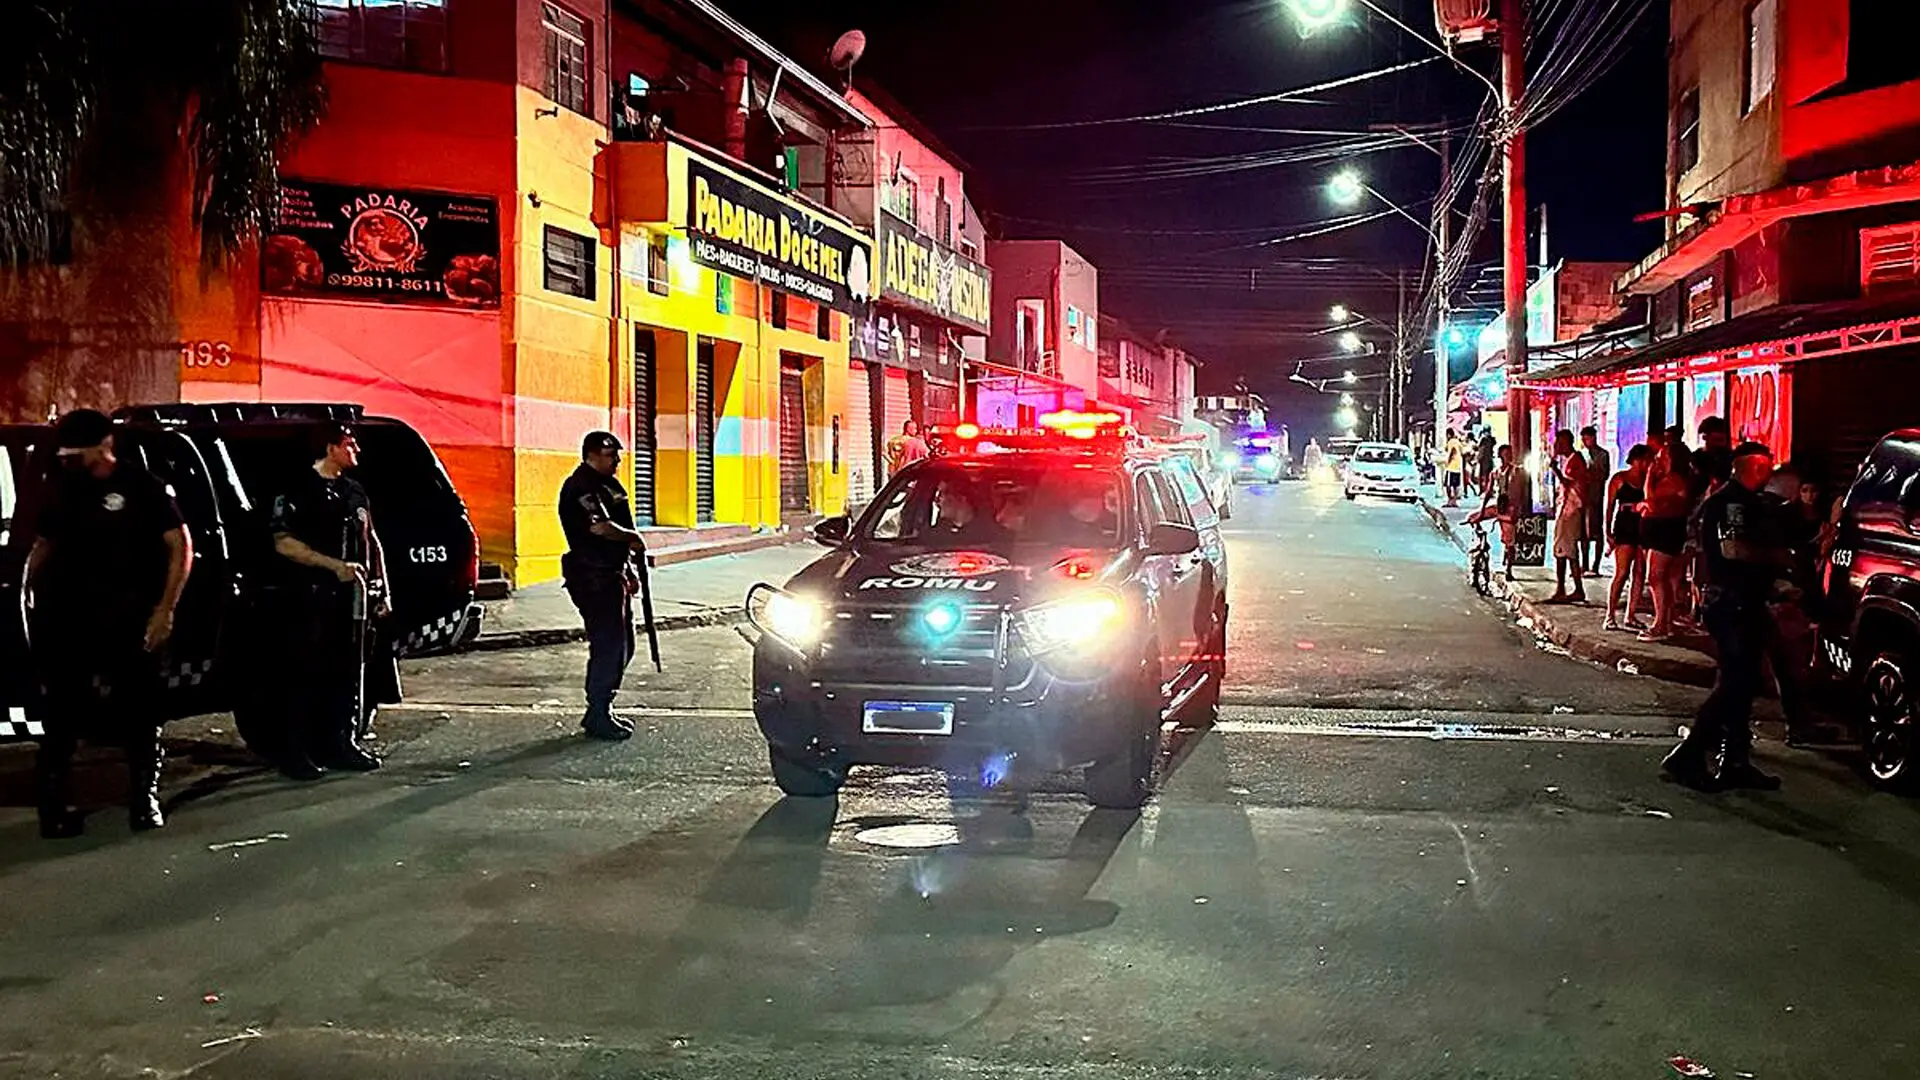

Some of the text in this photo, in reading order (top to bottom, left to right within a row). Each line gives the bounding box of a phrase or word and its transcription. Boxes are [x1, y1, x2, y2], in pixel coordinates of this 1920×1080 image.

[340, 193, 429, 230] PADARIA
[695, 175, 846, 286] PADARIA DOCE MEL
[341, 274, 442, 293] 99811-8611
[886, 230, 939, 311] ADEGA
[181, 341, 232, 367] 193
[416, 545, 448, 564] 153
[859, 576, 997, 592] ROMU
